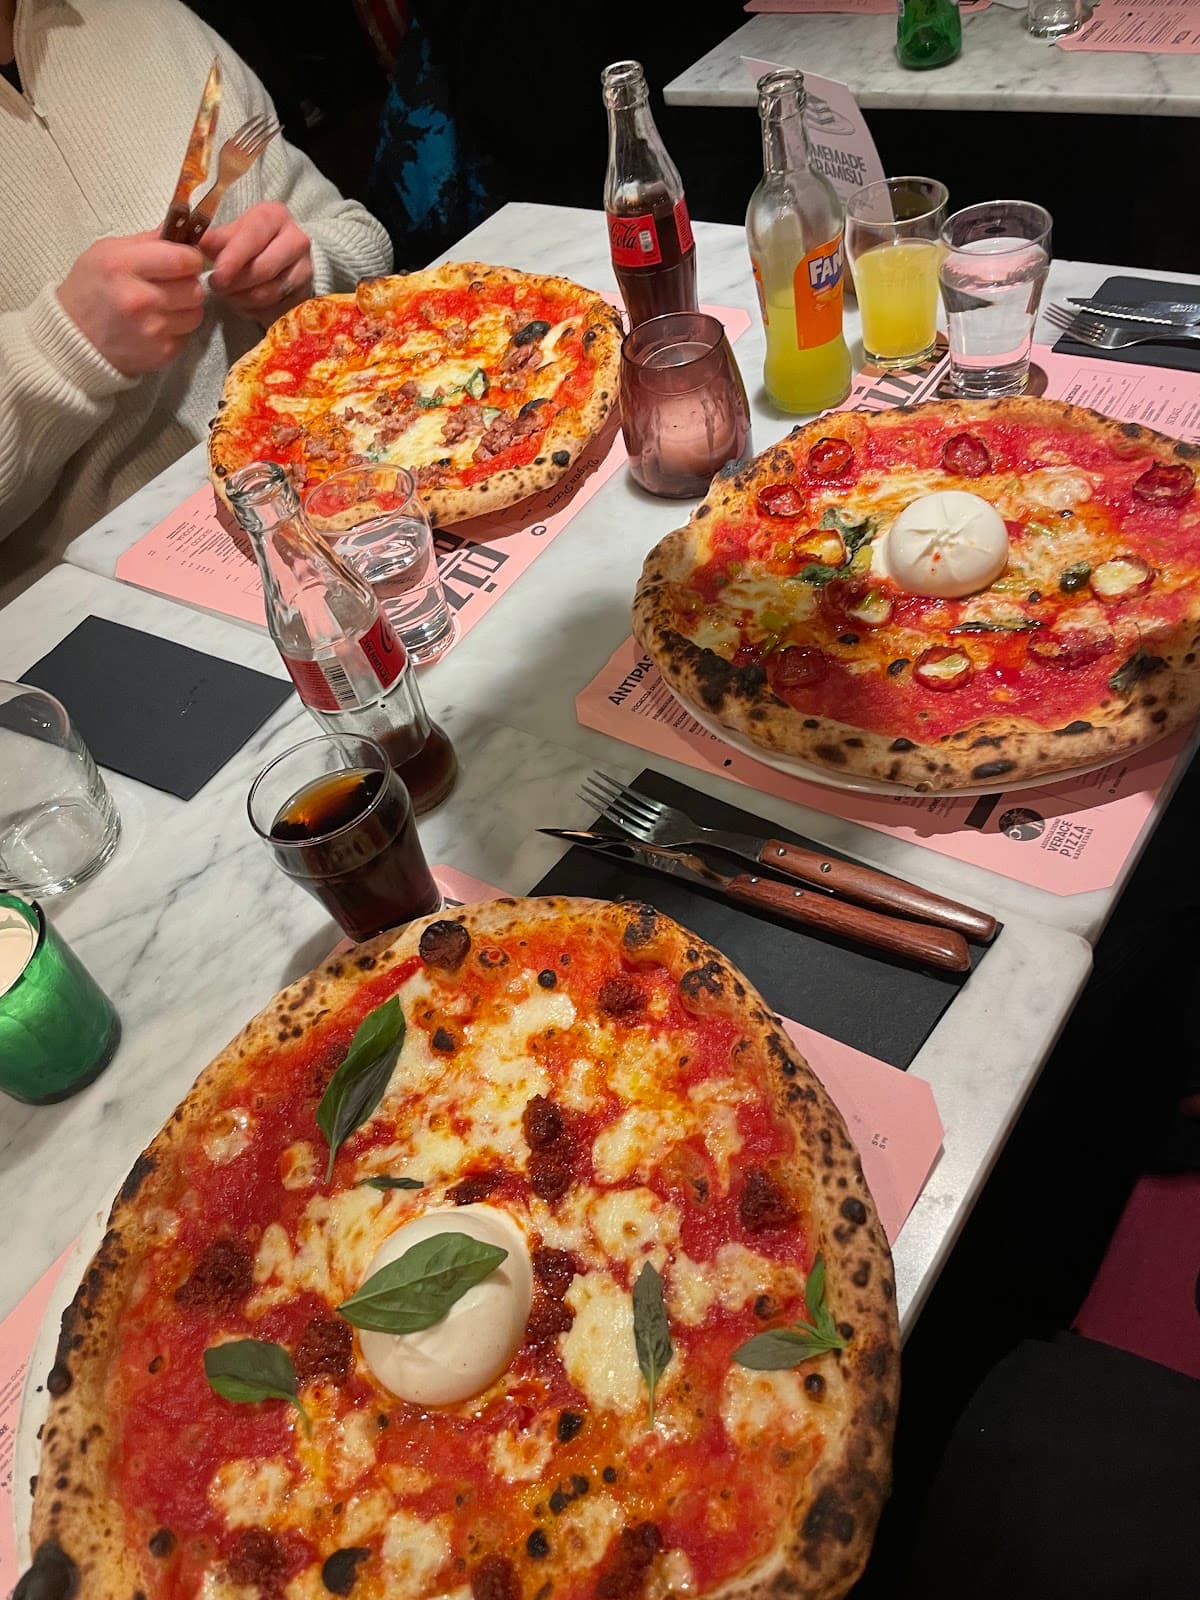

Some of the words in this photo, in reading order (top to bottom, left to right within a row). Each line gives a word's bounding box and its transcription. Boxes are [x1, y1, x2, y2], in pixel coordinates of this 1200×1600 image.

[809, 143, 867, 172] MEMADE
[814, 158, 863, 186] RAMISU
[808, 241, 844, 289] FAN
[608, 654, 655, 706] ANTIPAS
[1047, 820, 1073, 851] VERACE
[1059, 826, 1087, 857] PIZZA
